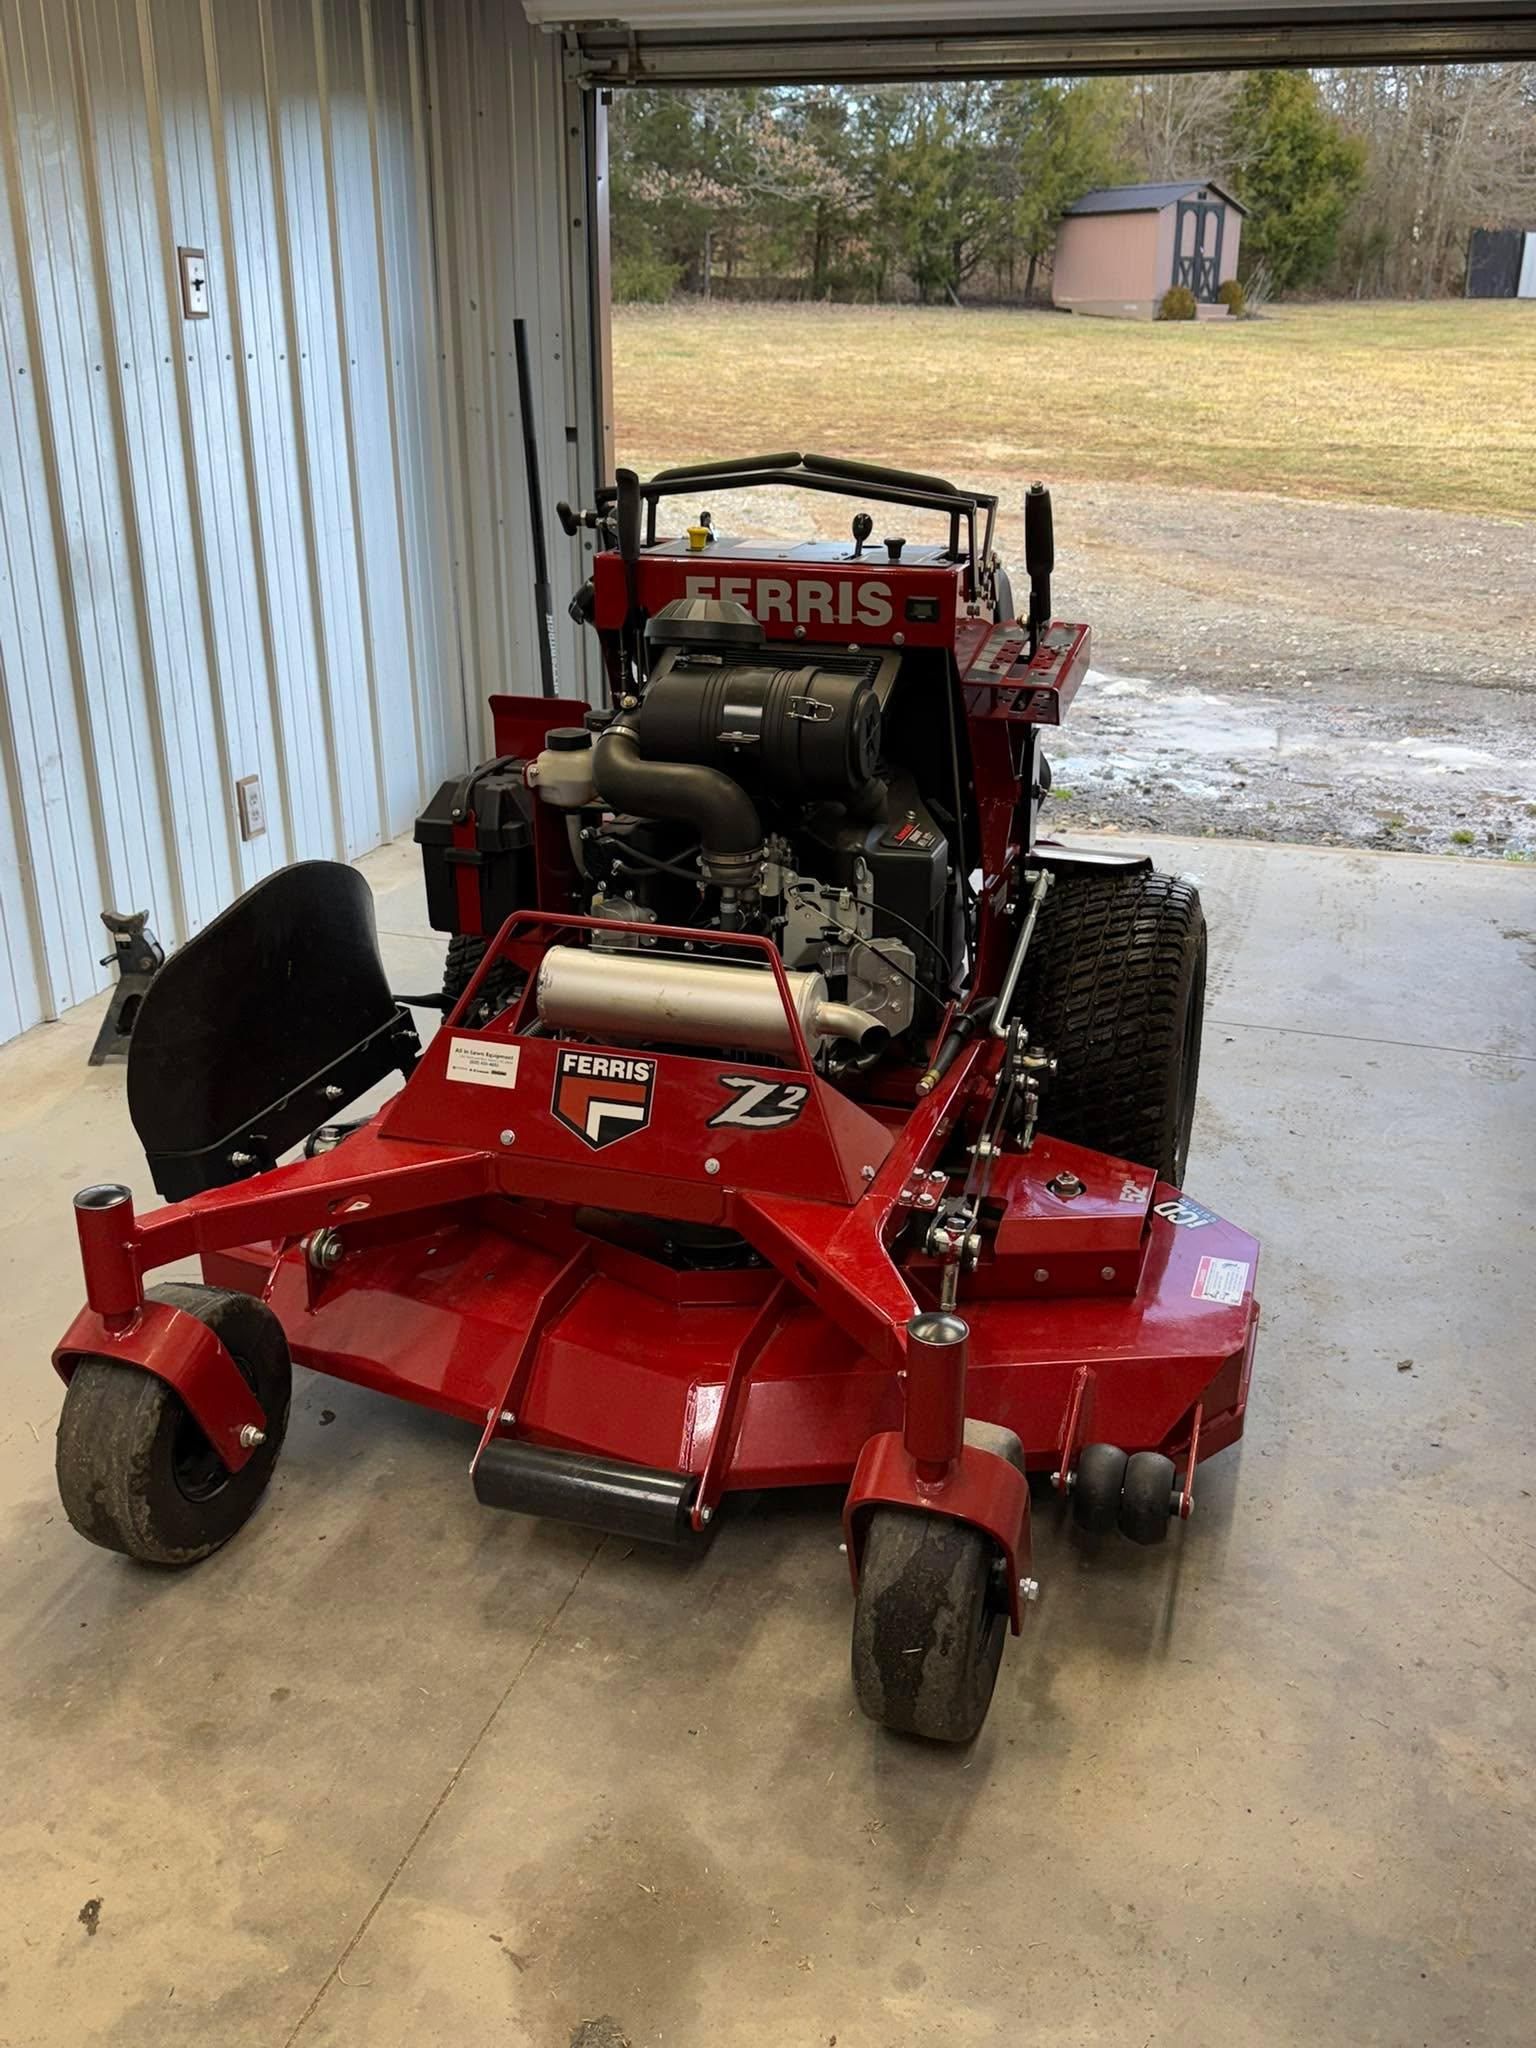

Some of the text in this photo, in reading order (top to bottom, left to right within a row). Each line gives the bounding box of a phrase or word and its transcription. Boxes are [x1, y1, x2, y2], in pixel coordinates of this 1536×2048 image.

[686, 576, 893, 626] FERRIS
[486, 1052, 514, 1060] Equipment
[562, 1054, 650, 1082] FERRIS
